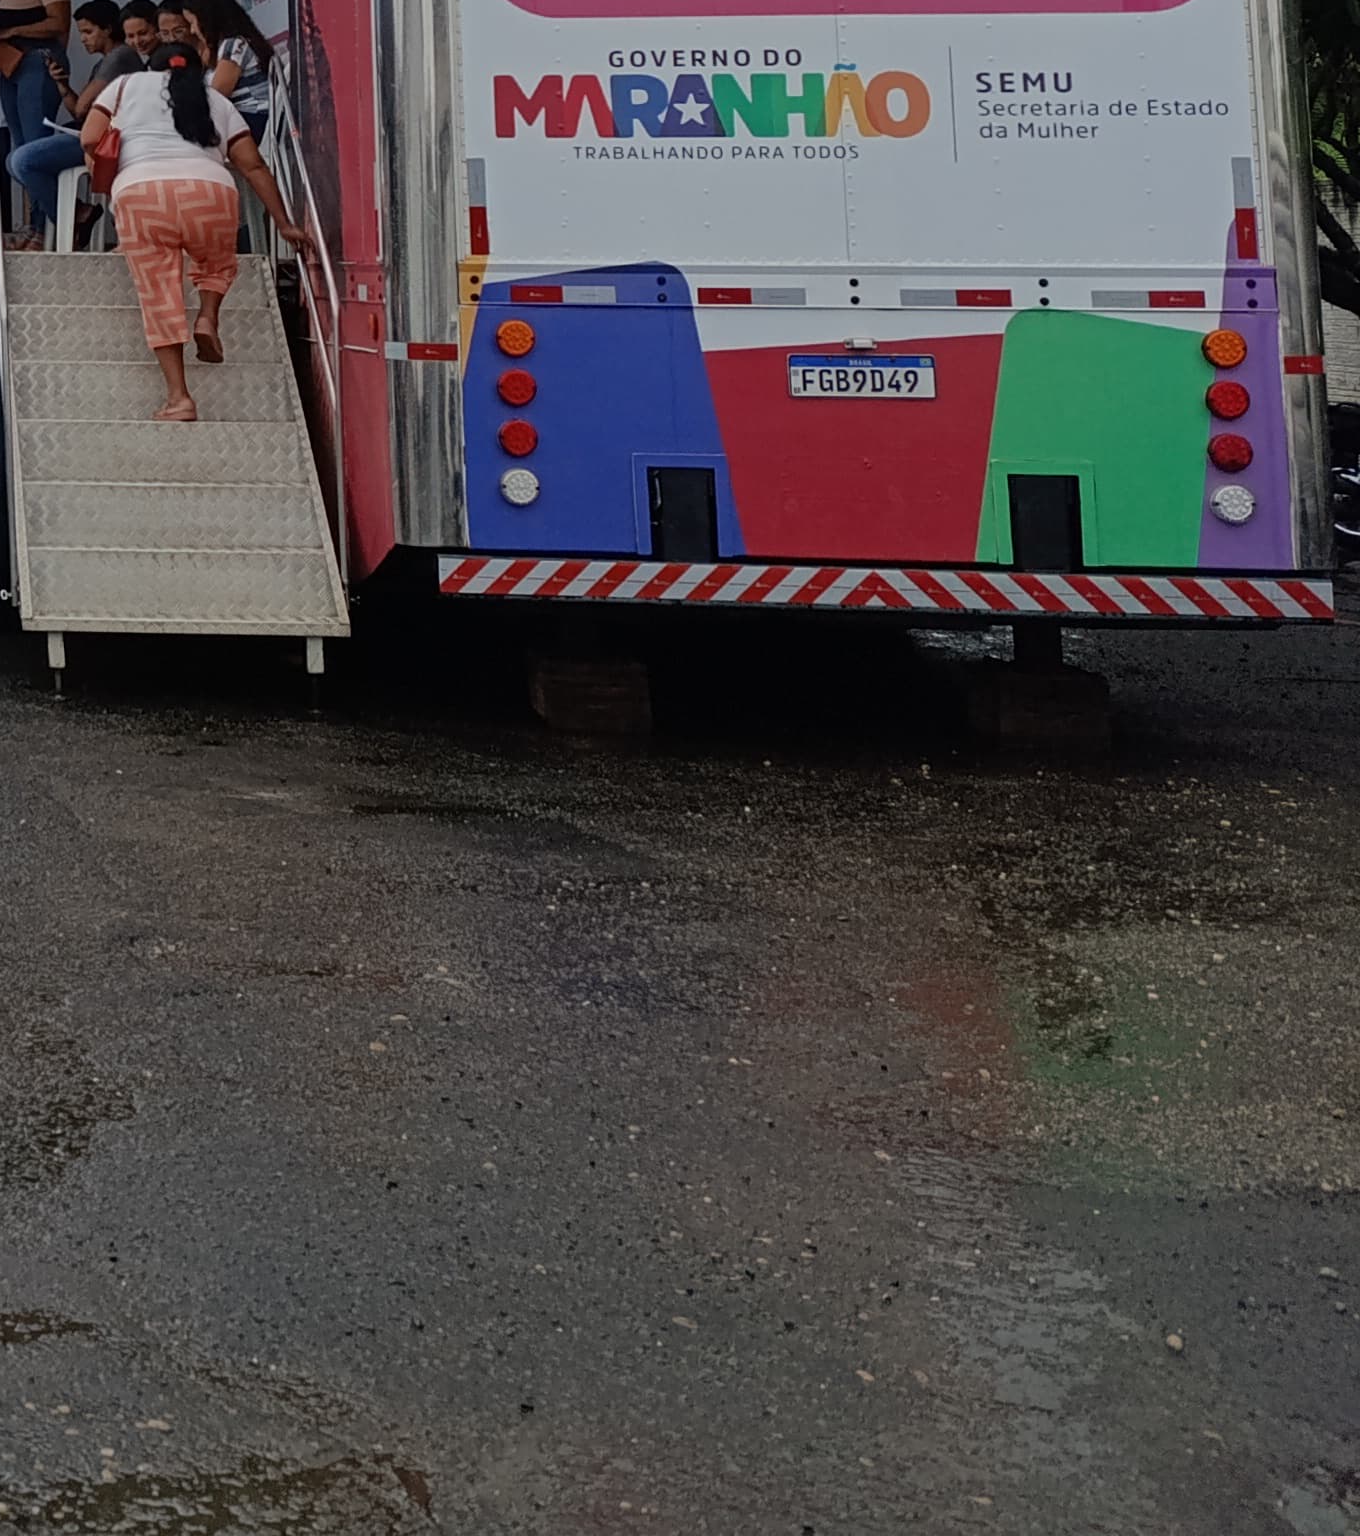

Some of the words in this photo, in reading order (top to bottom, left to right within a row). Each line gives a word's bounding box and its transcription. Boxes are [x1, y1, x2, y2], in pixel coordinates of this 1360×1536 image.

[608, 50, 750, 68] GOVERNO
[763, 48, 803, 66] DO
[976, 72, 1073, 94] SEMU
[493, 63, 931, 139] MARANHÃO
[978, 100, 1099, 116] Secretaria
[1108, 100, 1138, 116] de
[1147, 99, 1229, 116] Estado
[980, 122, 1008, 139] da
[1018, 122, 1099, 139] Mulher
[573, 145, 724, 161] TRABALHANDO
[731, 145, 784, 160] PARA
[792, 144, 860, 160] TODOS
[802, 369, 918, 393] FGB9D49
